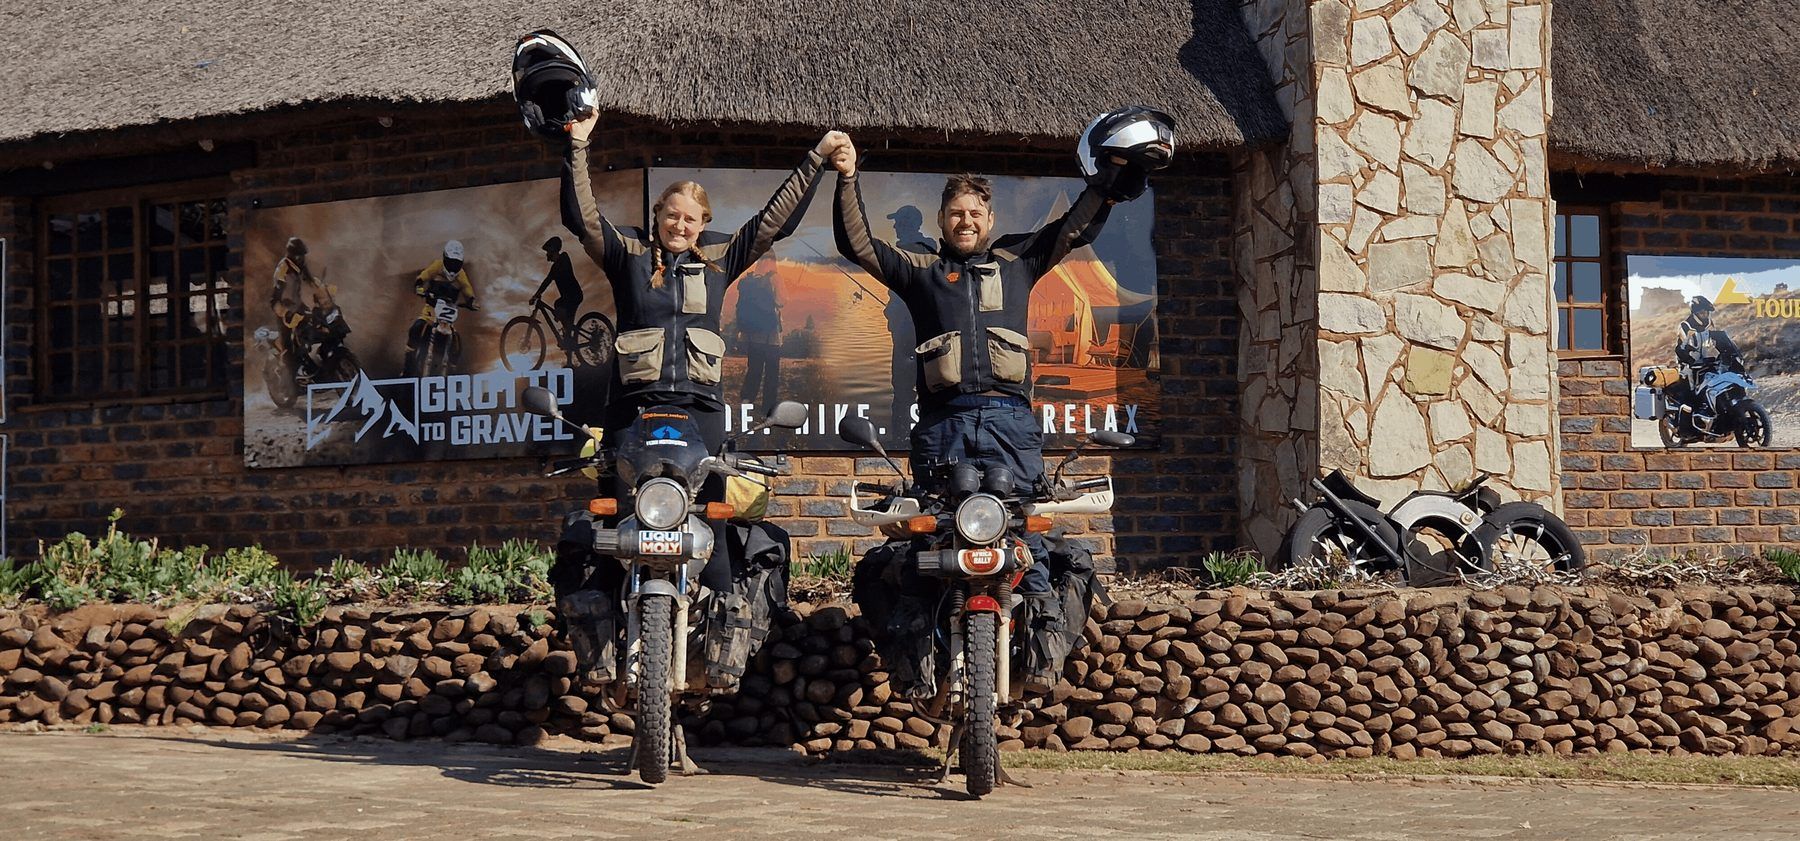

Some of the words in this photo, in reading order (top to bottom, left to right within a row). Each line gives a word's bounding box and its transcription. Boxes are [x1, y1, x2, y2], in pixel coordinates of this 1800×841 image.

[439, 307, 456, 321] 2
[420, 367, 574, 413] GROTTO
[421, 422, 446, 442] TO
[451, 411, 574, 446] GRAVEL
[1042, 403, 1139, 434] RELAX
[642, 531, 679, 542] LIQUI
[642, 541, 680, 553] MOLY
